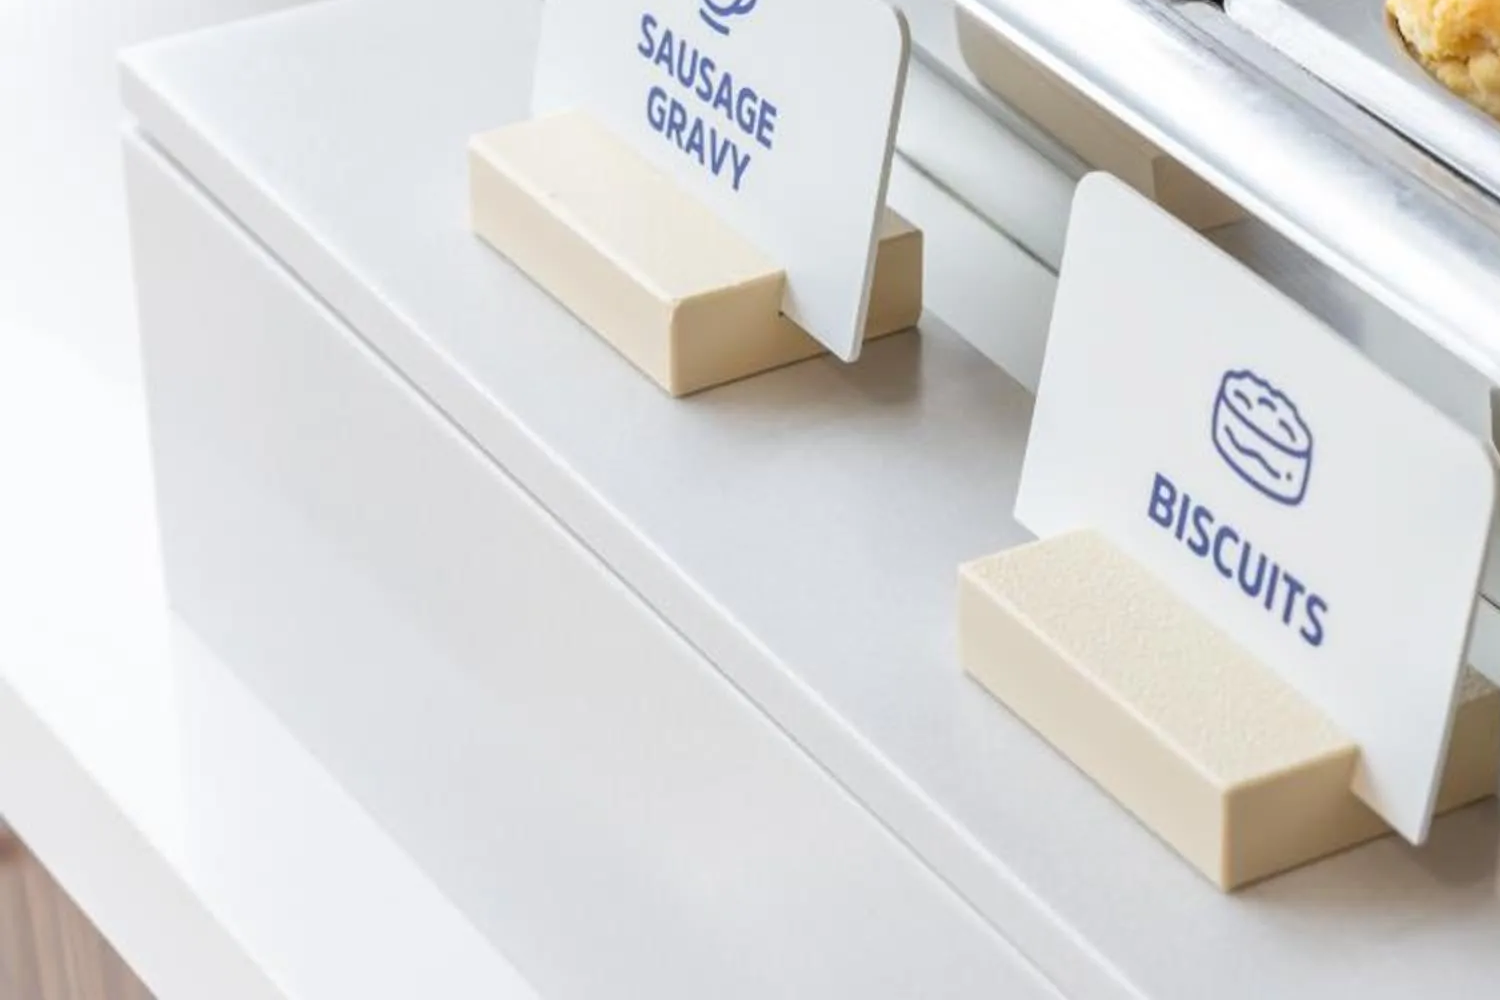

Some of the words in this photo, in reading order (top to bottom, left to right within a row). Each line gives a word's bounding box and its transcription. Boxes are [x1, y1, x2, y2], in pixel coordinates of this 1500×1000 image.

[637, 13, 778, 149] SAUSAGE
[646, 85, 751, 191] GRAVY
[1147, 471, 1328, 647] BISCUITS
